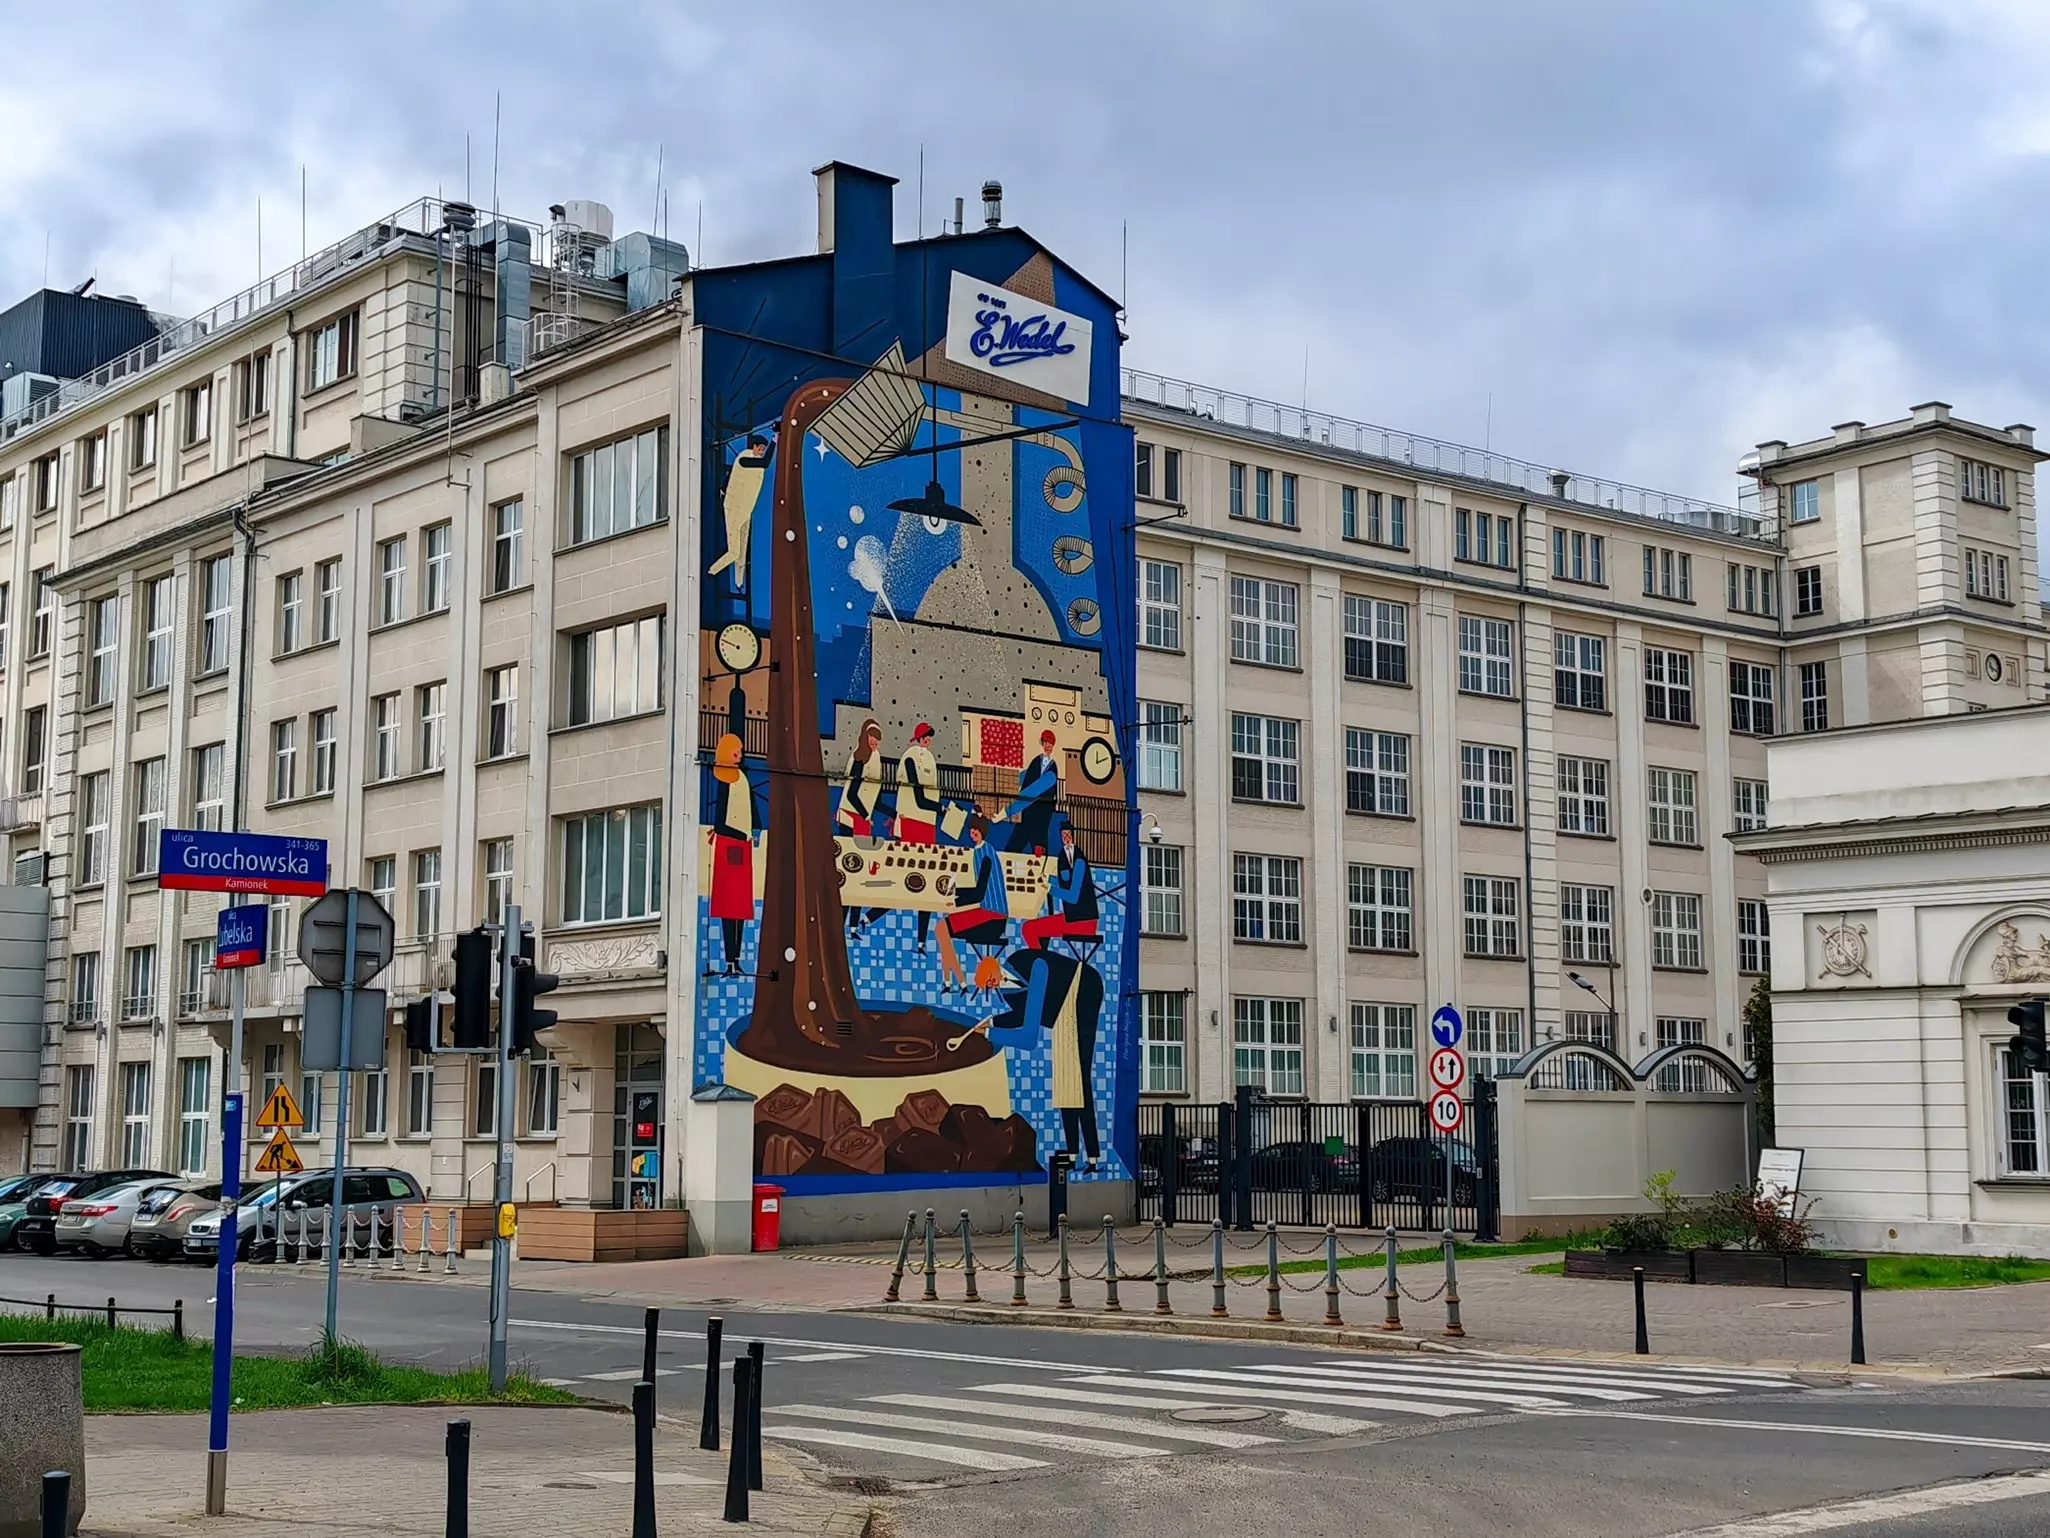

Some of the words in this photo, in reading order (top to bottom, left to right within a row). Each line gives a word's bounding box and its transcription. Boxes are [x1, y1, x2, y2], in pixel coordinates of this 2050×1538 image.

[171, 832, 194, 843] ulica
[285, 839, 320, 851] 341-365
[183, 846, 309, 874] Grochowska
[225, 878, 269, 890] Kamionek
[1437, 1101, 1457, 1120] 10
